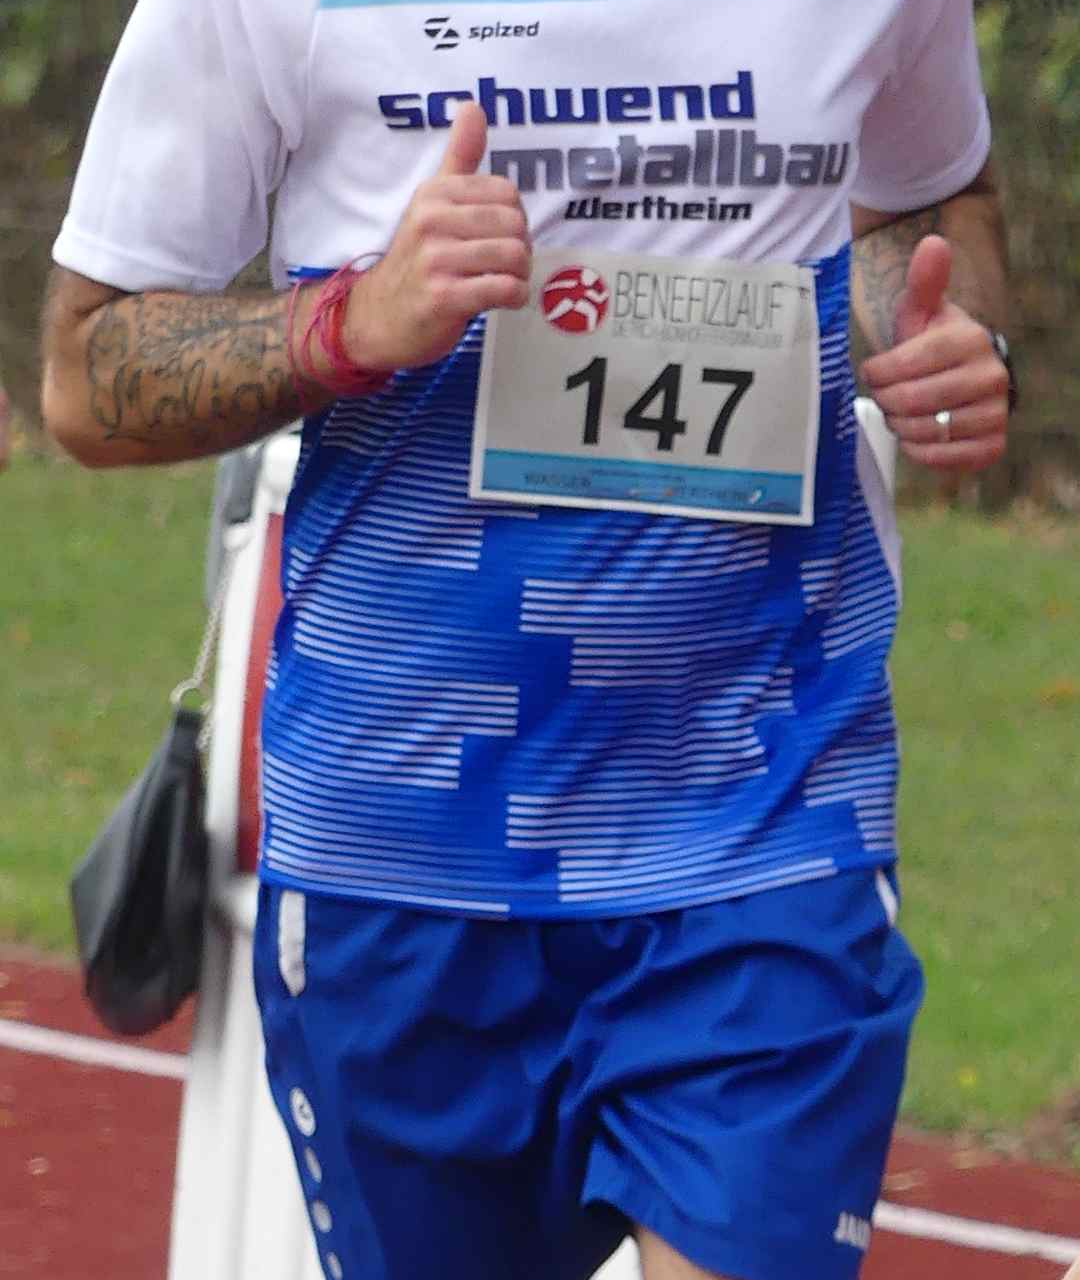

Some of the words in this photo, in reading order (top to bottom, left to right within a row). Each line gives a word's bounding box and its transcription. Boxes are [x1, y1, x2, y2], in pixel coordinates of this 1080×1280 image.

[468, 20, 540, 41] spized
[376, 70, 755, 131] schwend
[489, 128, 851, 192] metallbau
[612, 271, 784, 331] BENEFIZLAUF
[564, 355, 756, 456] 147
